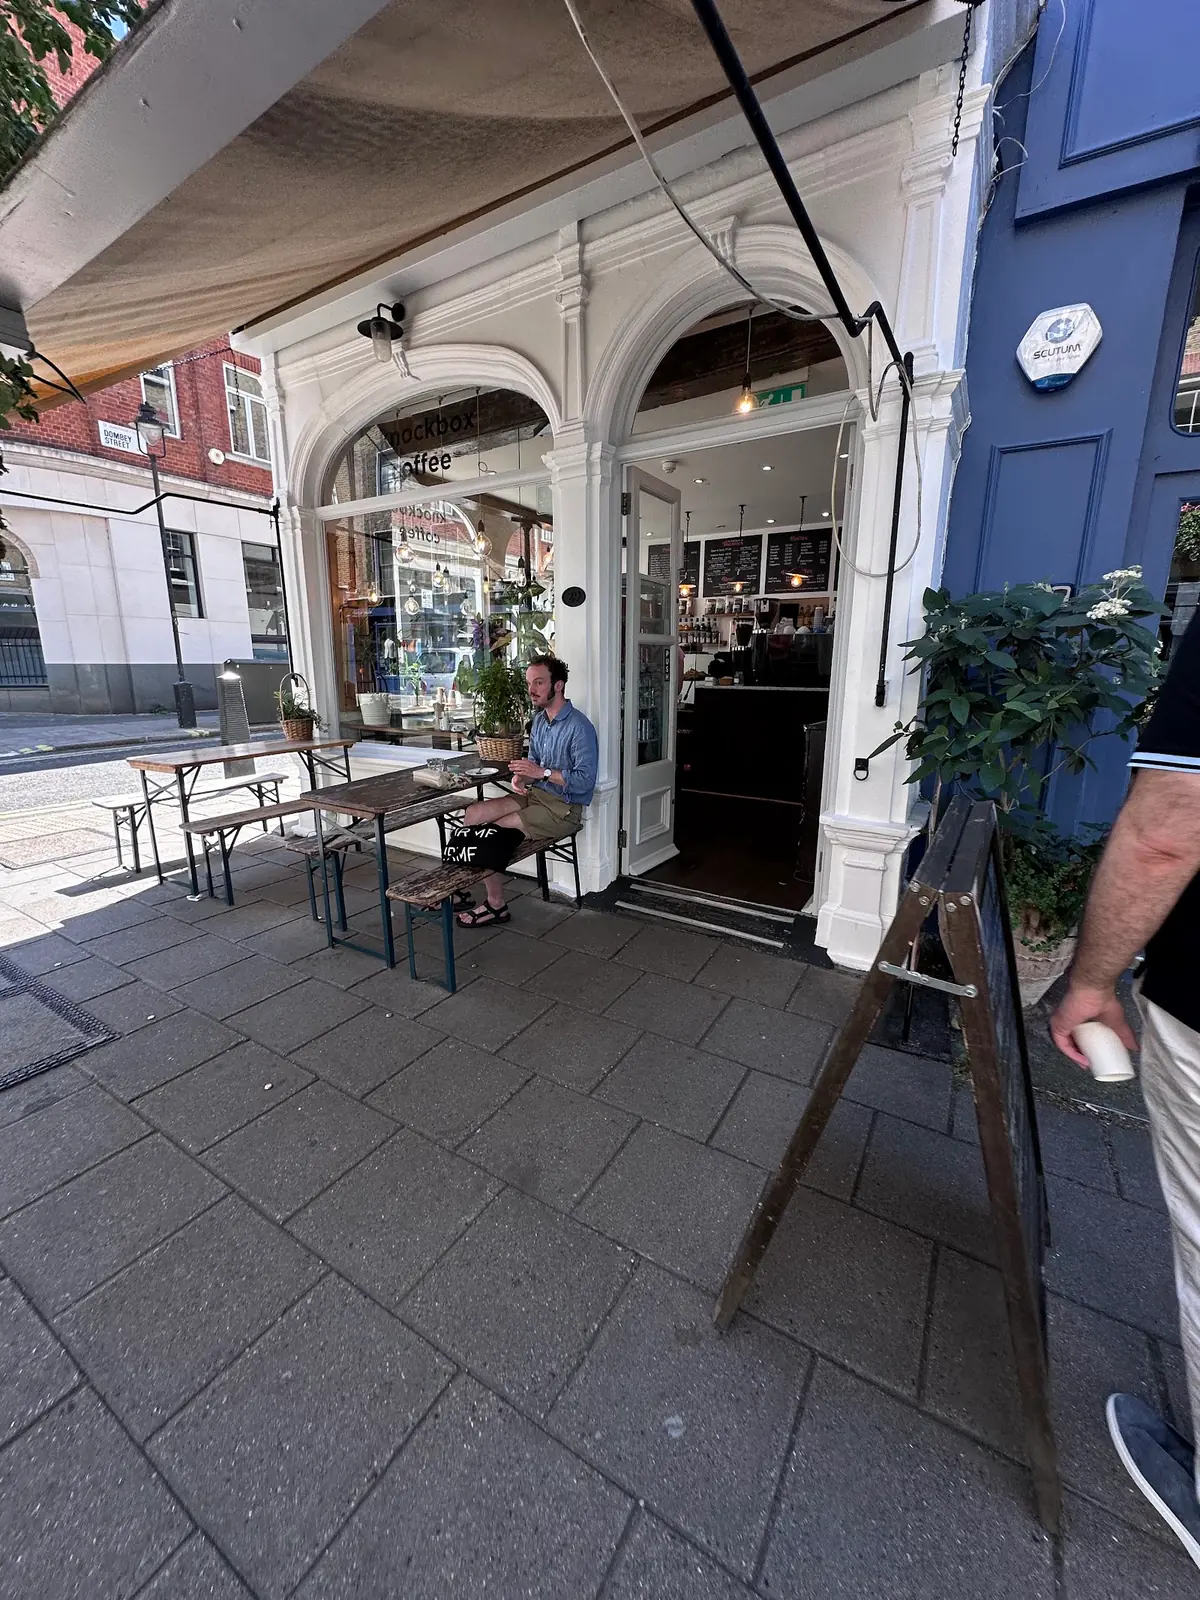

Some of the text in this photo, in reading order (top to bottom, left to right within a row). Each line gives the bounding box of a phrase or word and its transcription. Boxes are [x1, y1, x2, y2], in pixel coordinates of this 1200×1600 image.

[1033, 343, 1081, 360] SCUTUM
[103, 429, 132, 443] DOMBEY
[385, 411, 475, 446] nockbox
[104, 437, 130, 449] STREET
[401, 452, 452, 478] offee
